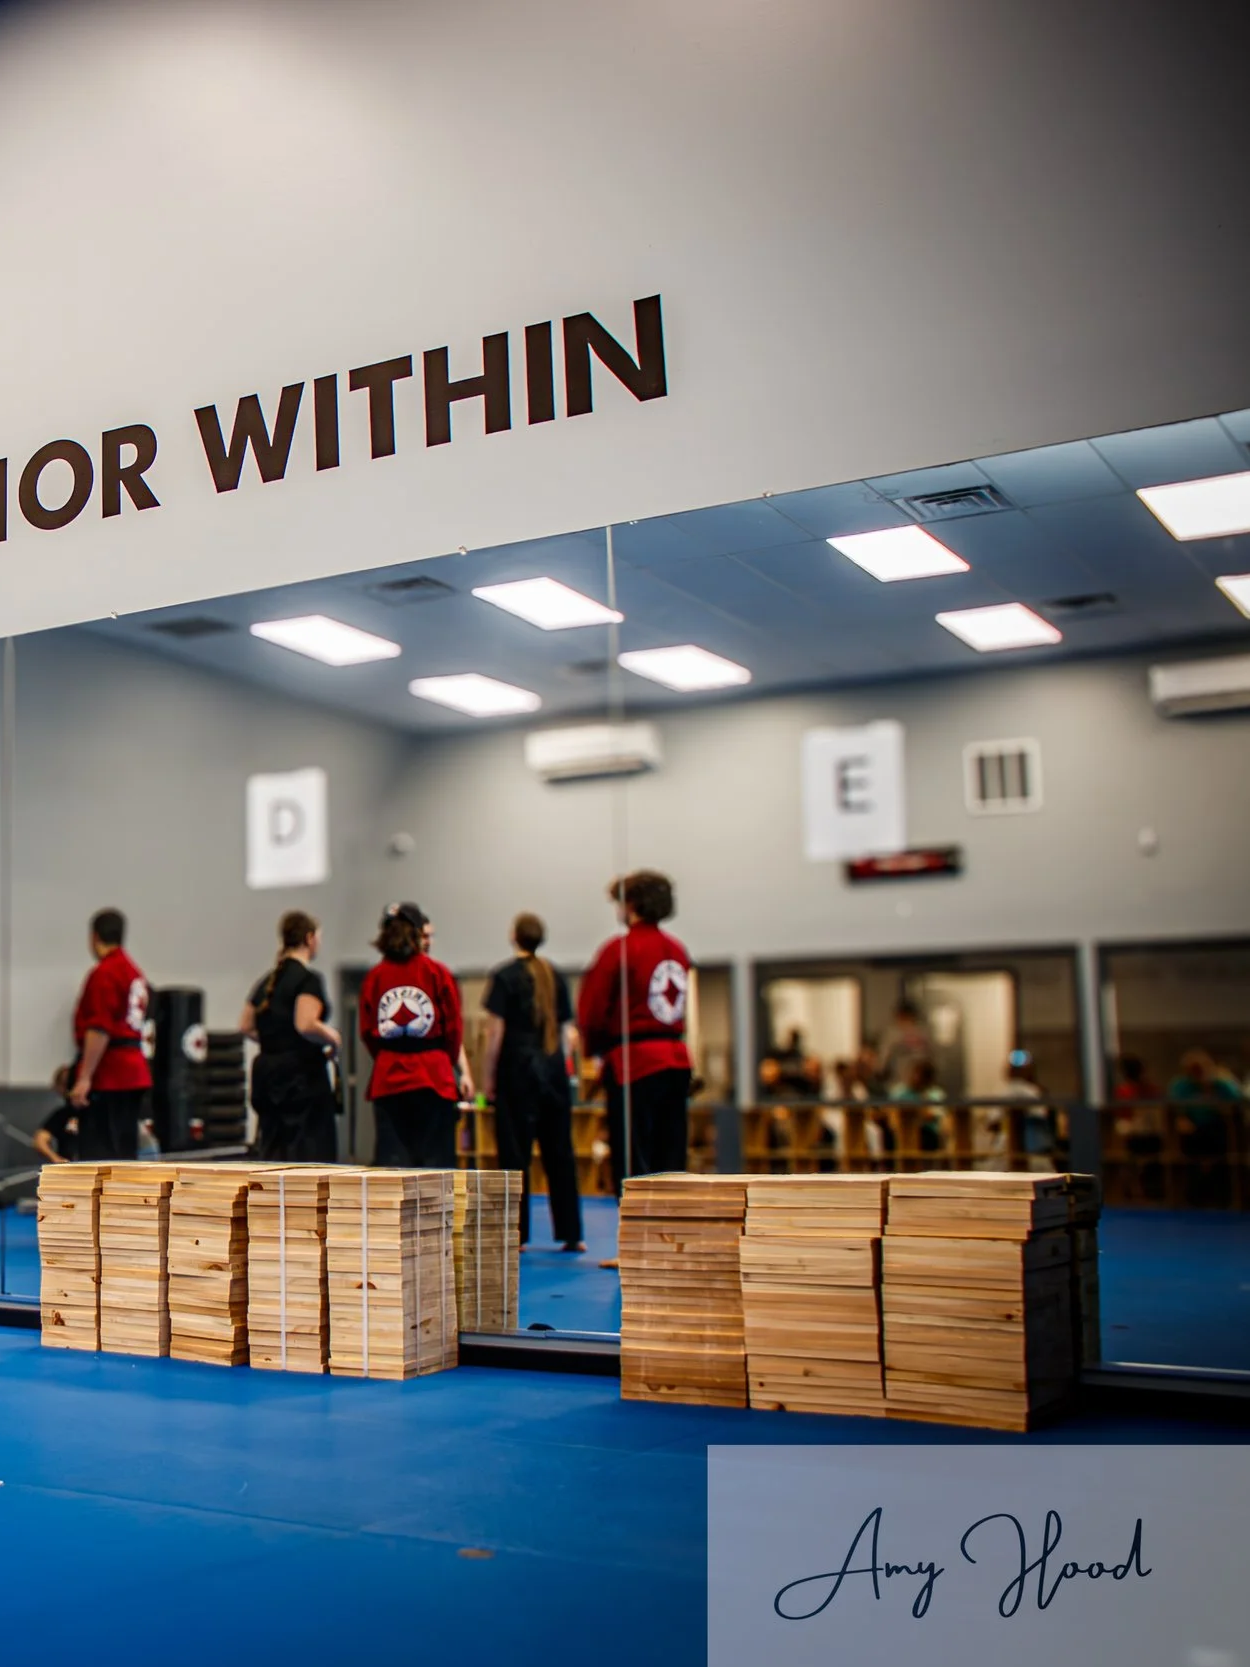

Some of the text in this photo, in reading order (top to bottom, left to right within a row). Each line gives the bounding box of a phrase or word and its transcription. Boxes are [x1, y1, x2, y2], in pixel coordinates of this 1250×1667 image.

[194, 293, 668, 494] WITHIN
[835, 755, 876, 816] E
[267, 797, 306, 848] D
